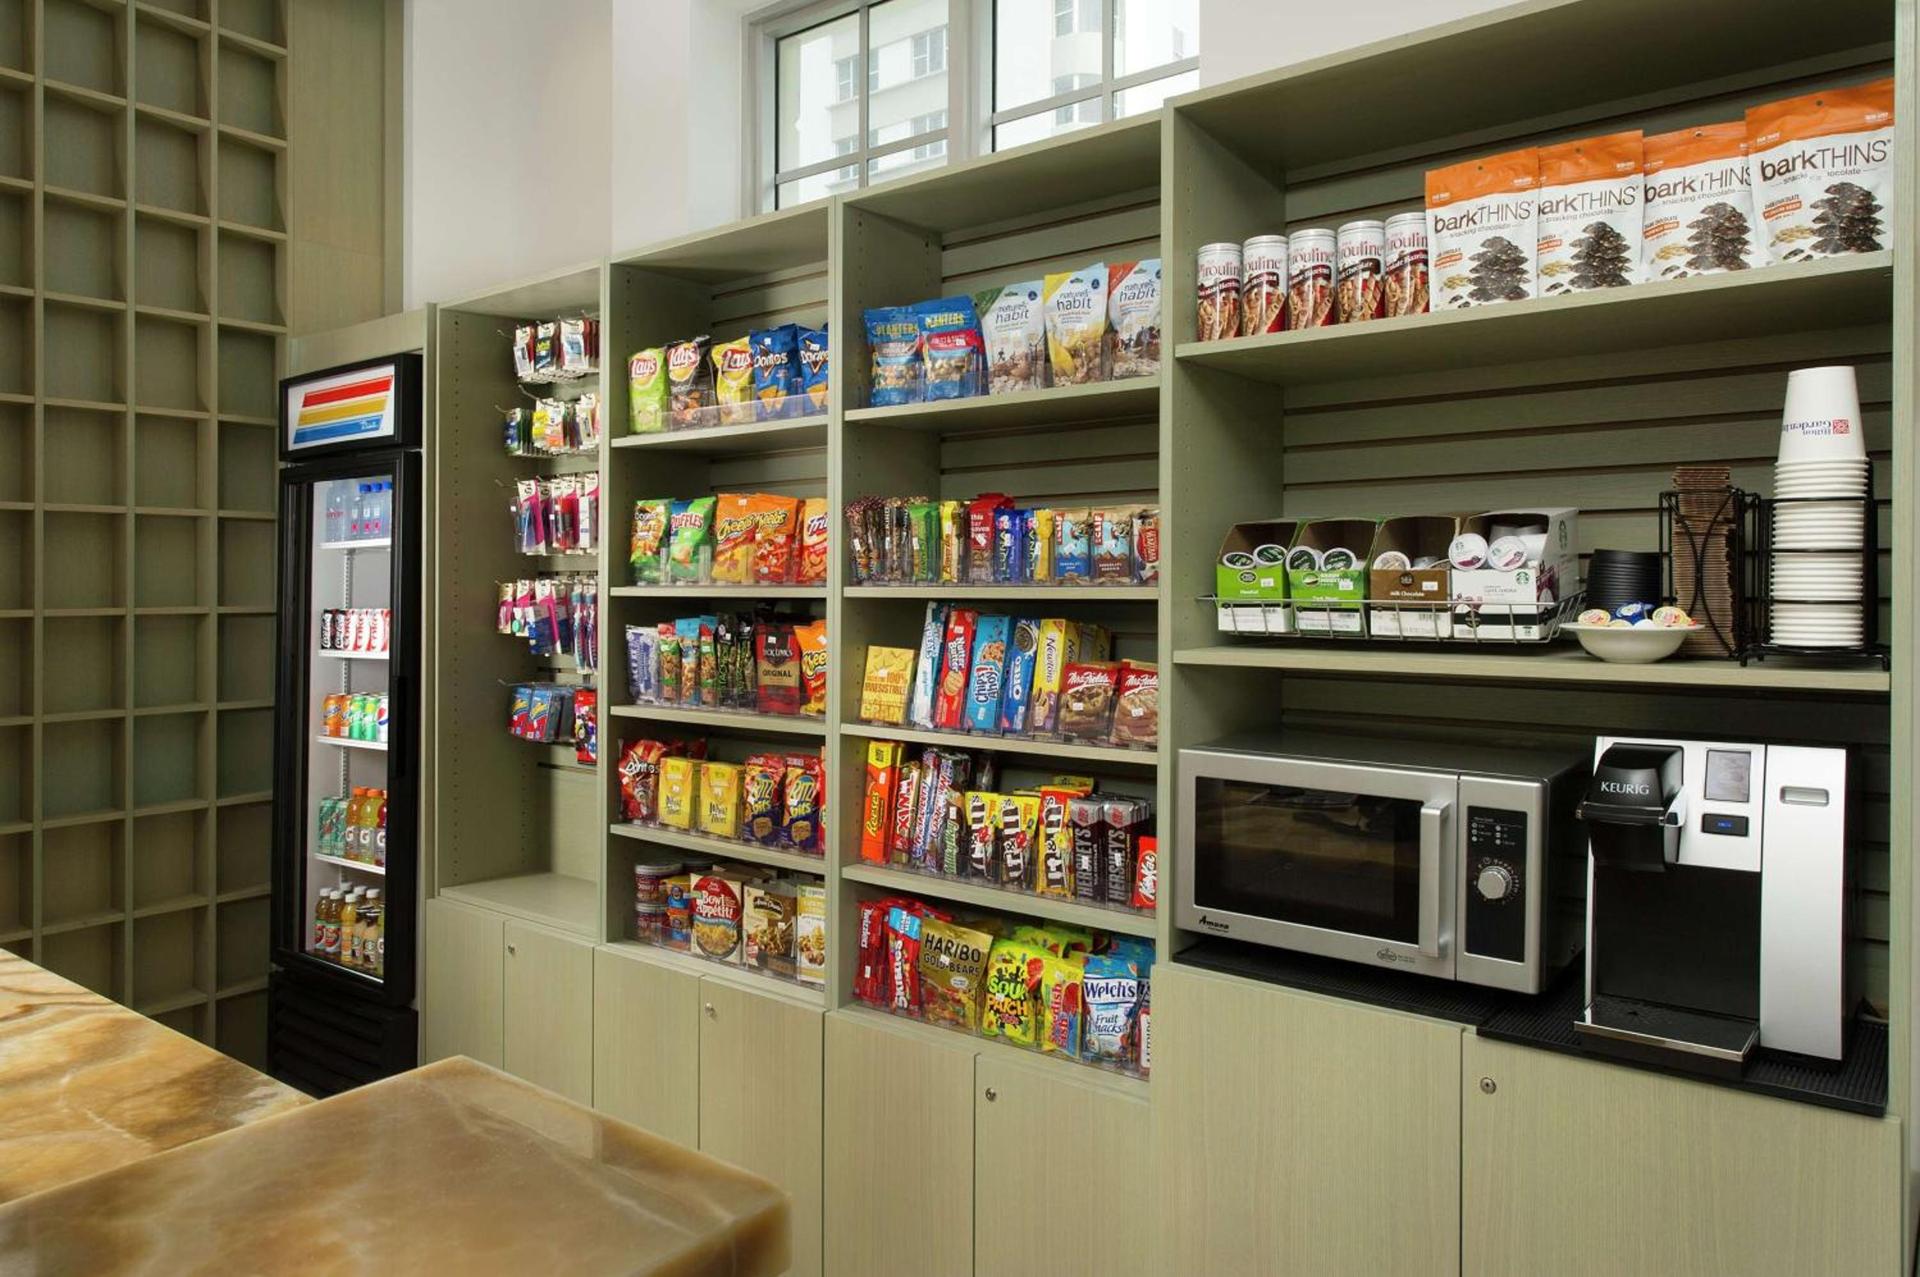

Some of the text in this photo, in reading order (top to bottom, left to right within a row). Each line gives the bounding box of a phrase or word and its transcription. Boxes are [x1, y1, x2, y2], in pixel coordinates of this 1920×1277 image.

[1760, 140, 1889, 181] barkTHINS
[1537, 185, 1637, 216] arkTHINS
[1434, 200, 1532, 235] barkTHINS
[1120, 287, 1157, 302] habit
[1057, 298, 1092, 312] habit
[995, 309, 1030, 325] habit
[754, 352, 788, 368] Doritos
[948, 642, 958, 672] Butter
[955, 636, 965, 669] Nutter
[1046, 636, 1056, 685] Newtons
[1013, 655, 1022, 700] OREO
[1600, 780, 1650, 796] KEURIG
[360, 828, 371, 844] G
[702, 889, 726, 907] Bowl
[1199, 914, 1230, 930] Amana
[924, 932, 981, 962] HARIBO
[1085, 980, 1136, 999] Welch's
